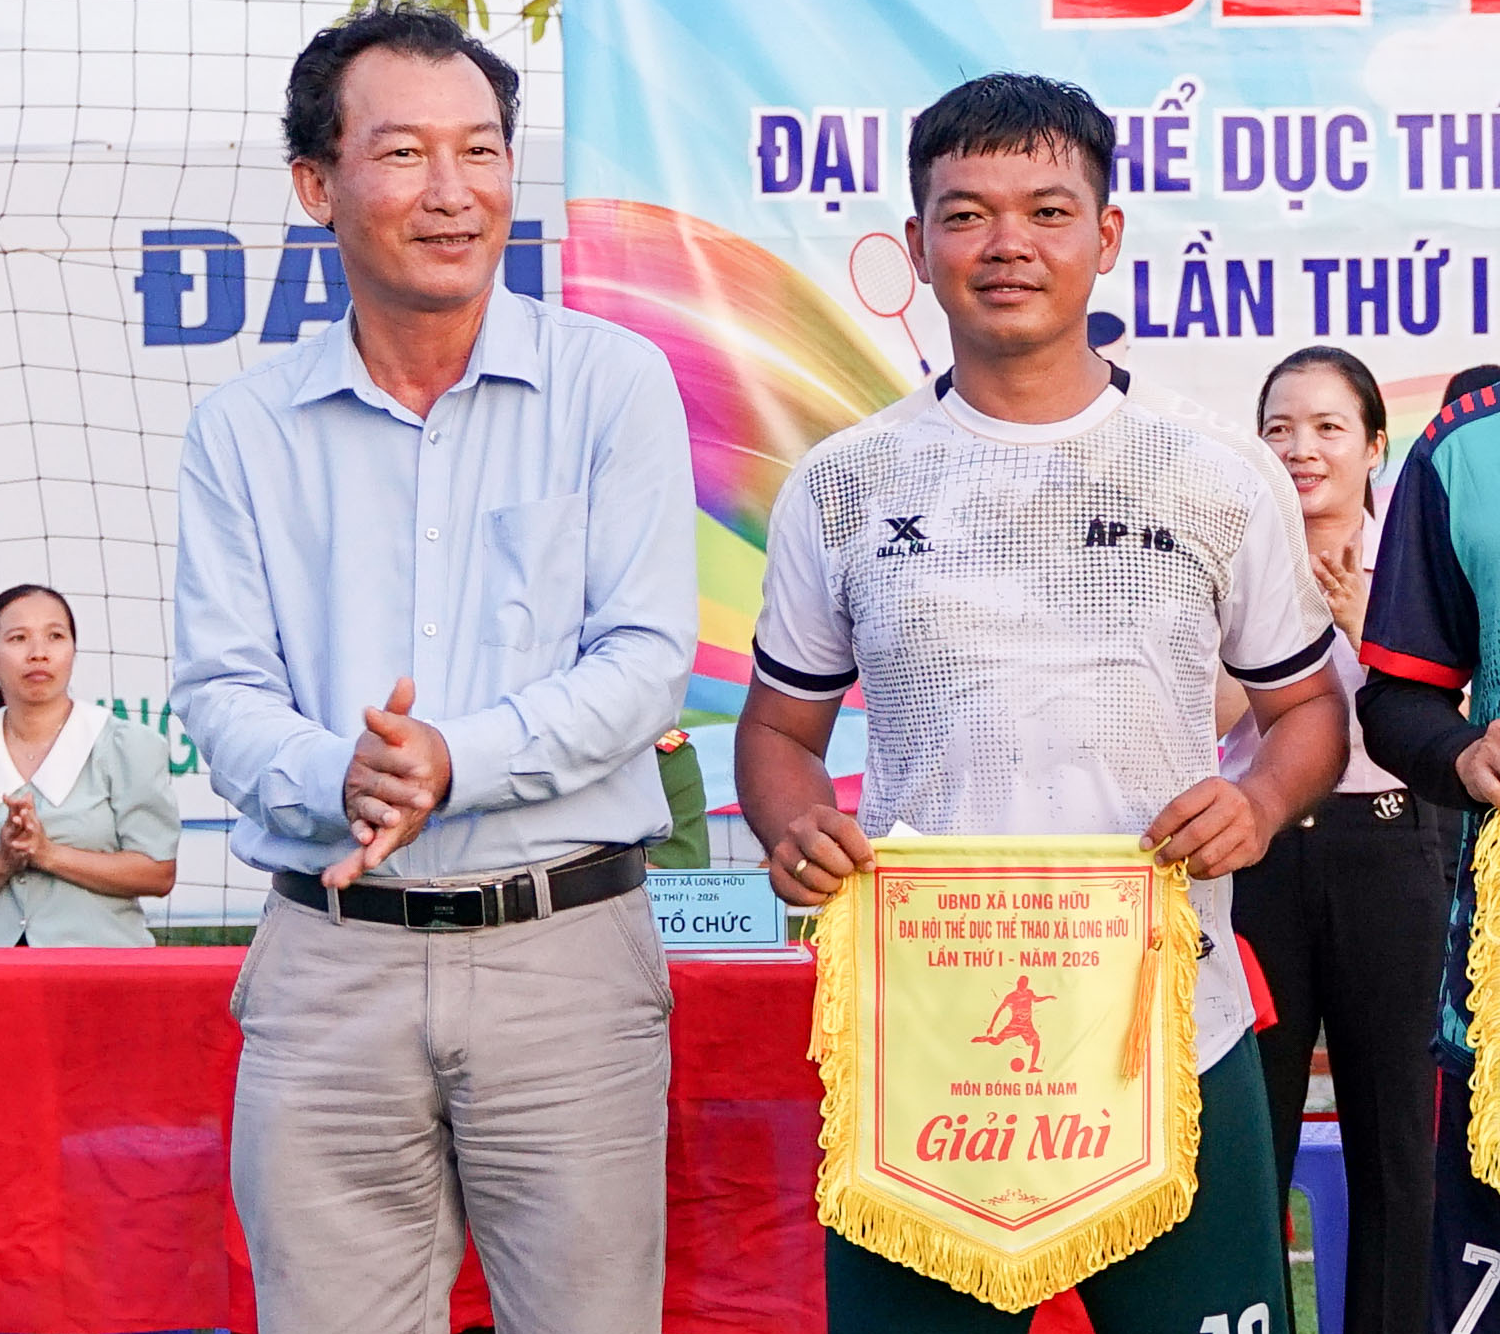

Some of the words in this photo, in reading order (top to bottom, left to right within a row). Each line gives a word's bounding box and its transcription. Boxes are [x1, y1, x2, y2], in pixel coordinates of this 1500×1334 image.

[756, 114, 879, 212] ĐẠI
[1108, 82, 1191, 192] HỂ
[1222, 114, 1367, 210] DỤC
[1135, 230, 1274, 338] LẦN
[1304, 238, 1450, 335] THỨ
[1472, 258, 1487, 335] I
[695, 878, 720, 886] LONG
[938, 893, 981, 910] UBND
[986, 890, 1008, 910] XÃ
[1012, 893, 1053, 910] LONG
[1059, 891, 1090, 910] HỮU
[658, 908, 686, 933] TỔ
[692, 911, 752, 933] CHỨC
[899, 920, 918, 943] ĐẠI
[922, 917, 941, 943] HỘI
[945, 913, 966, 939] THỂ
[970, 920, 992, 943] DỤC
[997, 913, 1018, 939] THỂ
[1021, 920, 1050, 939] THAO
[1054, 917, 1069, 939] XÃ
[1073, 920, 1102, 939] LONG
[928, 945, 958, 967] LẦN
[964, 948, 995, 967] THỨ
[1020, 947, 1057, 967] NĂM
[1062, 951, 1100, 967] 2026
[950, 1080, 981, 1096] MÔN
[985, 1080, 1021, 1096] BÓNG
[1025, 1079, 1043, 1096] ĐÁ
[1047, 1082, 1077, 1096] NAM
[916, 1111, 1018, 1162] Giải
[1027, 1108, 1111, 1162] Nhì
